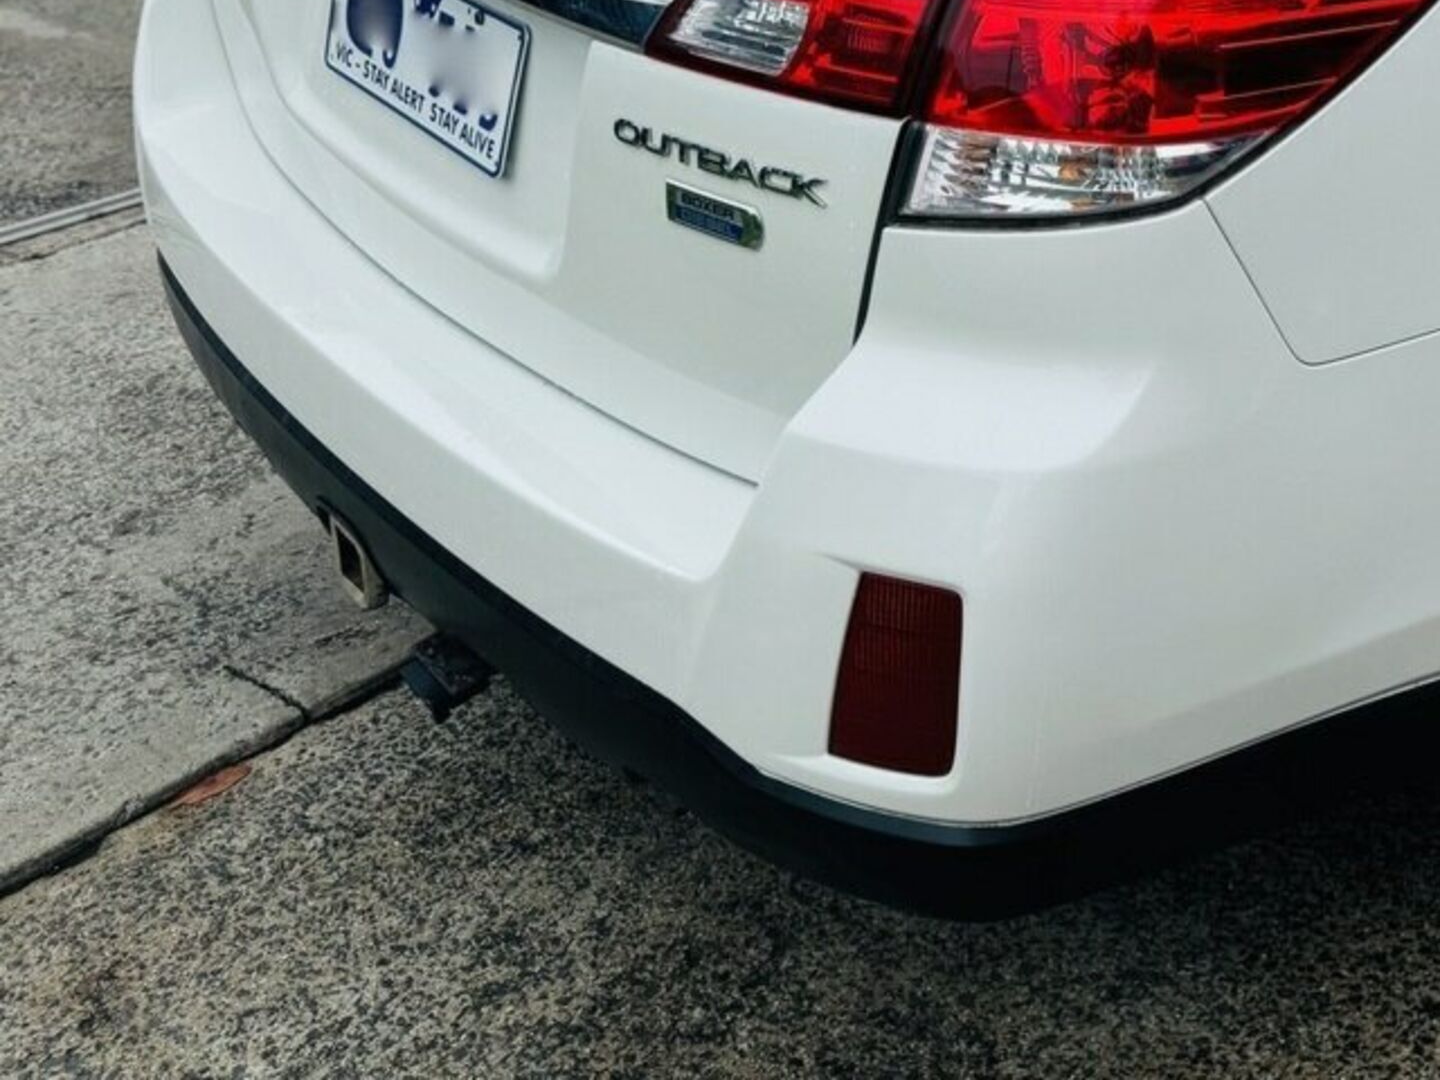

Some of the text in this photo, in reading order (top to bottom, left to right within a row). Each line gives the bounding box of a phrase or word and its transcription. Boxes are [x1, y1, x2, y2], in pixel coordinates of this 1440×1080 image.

[335, 41, 354, 68] VIC
[363, 59, 390, 90] STAY
[391, 78, 425, 114] ALERT
[428, 102, 460, 136] STAY
[460, 122, 495, 159] ALIVE
[613, 118, 828, 209] OUTBACK
